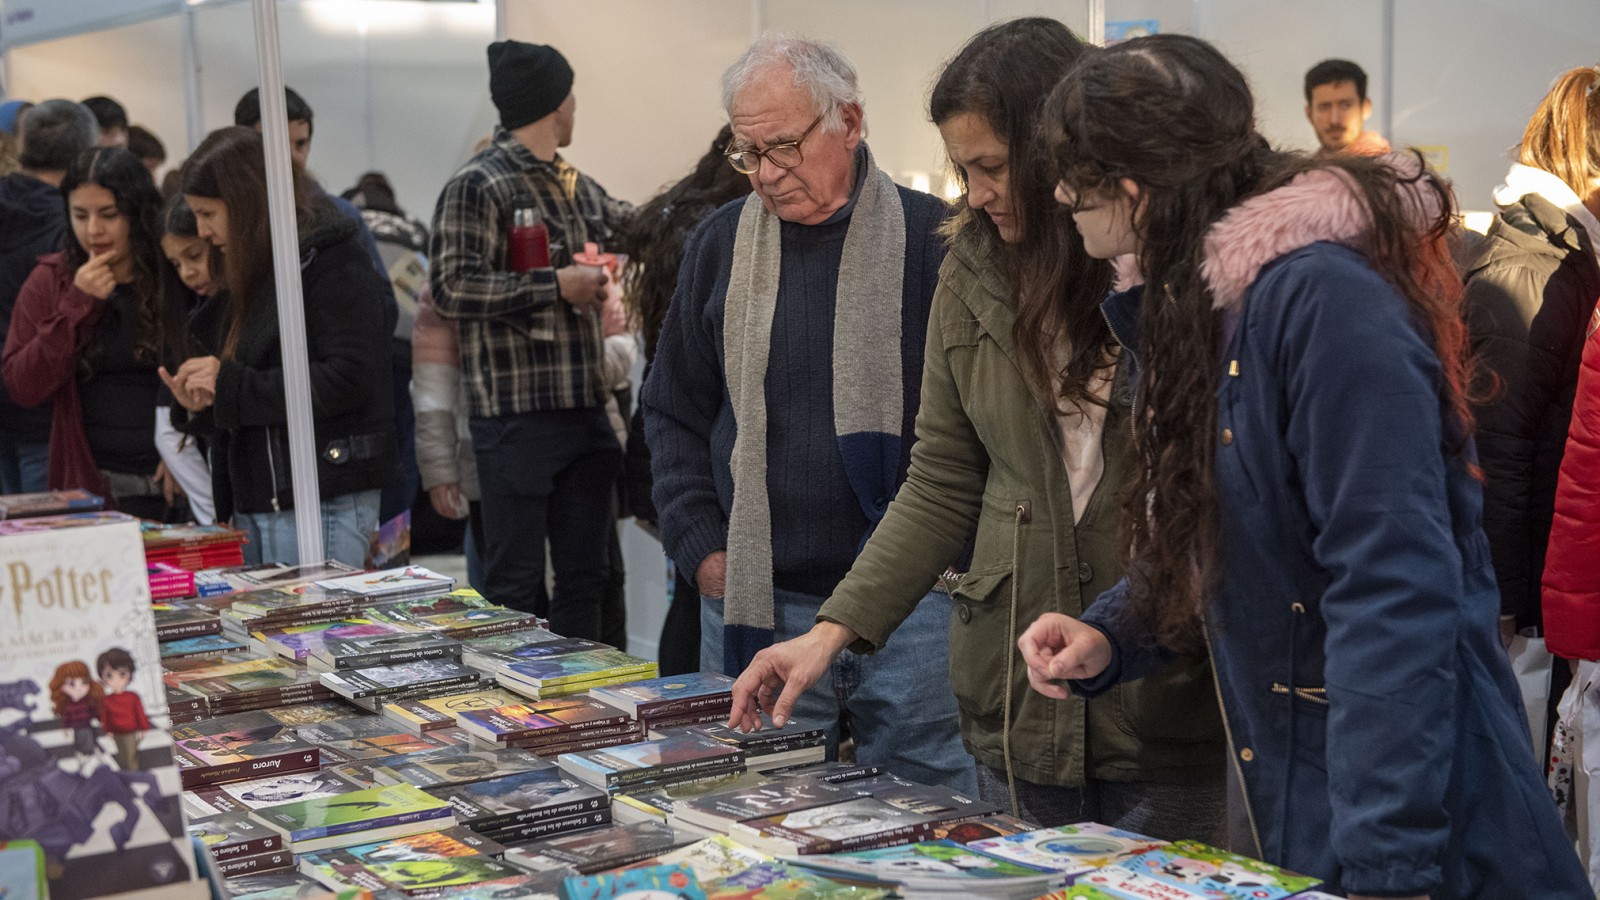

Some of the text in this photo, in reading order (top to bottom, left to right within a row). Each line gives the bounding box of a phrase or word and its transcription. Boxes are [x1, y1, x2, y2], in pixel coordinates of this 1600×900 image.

[7, 561, 112, 632] Potter
[390, 652, 416, 660] Fantasmas
[424, 649, 443, 658] Cuentos
[252, 759, 281, 770] Aurora
[824, 774, 841, 783] Canterville
[558, 804, 578, 812] Sabueso
[517, 810, 543, 821] Baskerville
[562, 818, 582, 827] Sabueso
[521, 824, 547, 835] Baskerville
[220, 846, 240, 854] Señora
[228, 862, 248, 870] Señora
